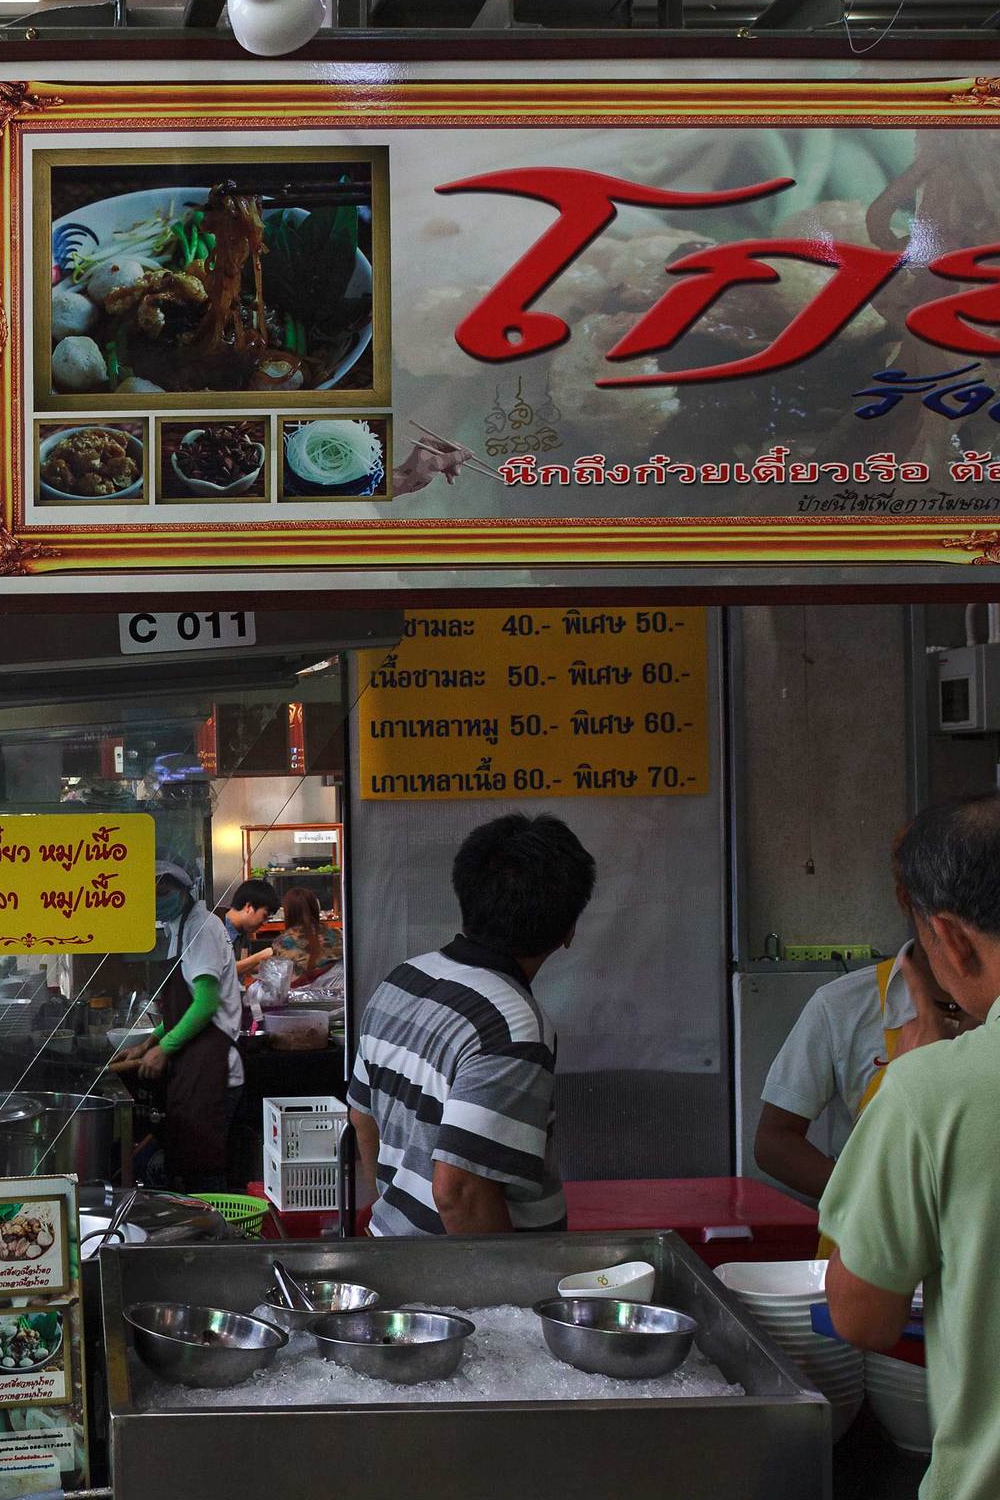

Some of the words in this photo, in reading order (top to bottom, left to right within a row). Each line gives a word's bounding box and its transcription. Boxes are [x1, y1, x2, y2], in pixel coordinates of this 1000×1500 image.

[499, 446, 930, 486] นึกถึงก๋วยเตี๋ยวเรือ
[129, 613, 157, 643] C
[177, 612, 246, 640] 011
[502, 615, 551, 637] 40.-
[562, 609, 627, 637] พิเศษ
[635, 612, 685, 633] 50.-
[370, 653, 486, 689] เนื้อชามละ
[507, 665, 556, 687] 50.-
[568, 660, 632, 686] พิเศษ
[642, 662, 691, 684] 60.-
[370, 717, 499, 745] เกาเหลาหมู
[510, 714, 559, 736] 50.-
[569, 709, 634, 735] พิเศษ
[644, 712, 693, 734] 60.-
[371, 757, 507, 793] เกาเหลาเนื้อ
[513, 768, 562, 790] 60.-
[573, 763, 638, 789] พิเศษ
[647, 766, 697, 789] 70.-
[39, 826, 128, 871] หมู/เนื้อ
[40, 873, 126, 919] หมู/เนื้อ
